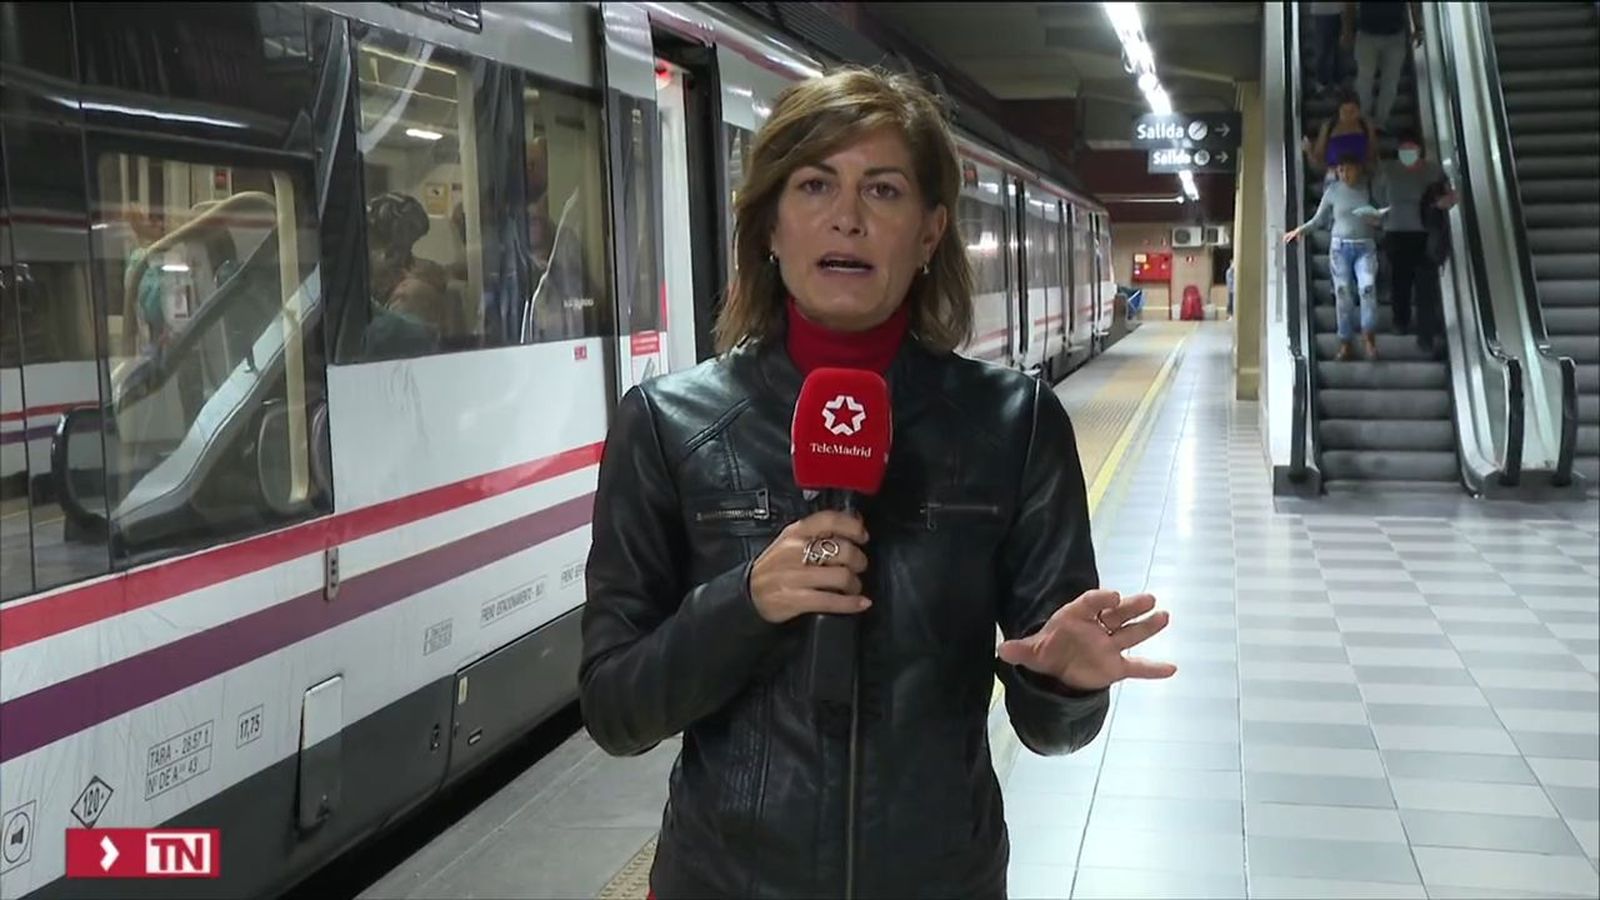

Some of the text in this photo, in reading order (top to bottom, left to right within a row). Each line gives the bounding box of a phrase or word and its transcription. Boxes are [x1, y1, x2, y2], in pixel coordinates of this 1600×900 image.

[1136, 122, 1184, 139] Salida
[810, 443, 872, 457] TeleMadrid
[150, 744, 171, 769] TARA
